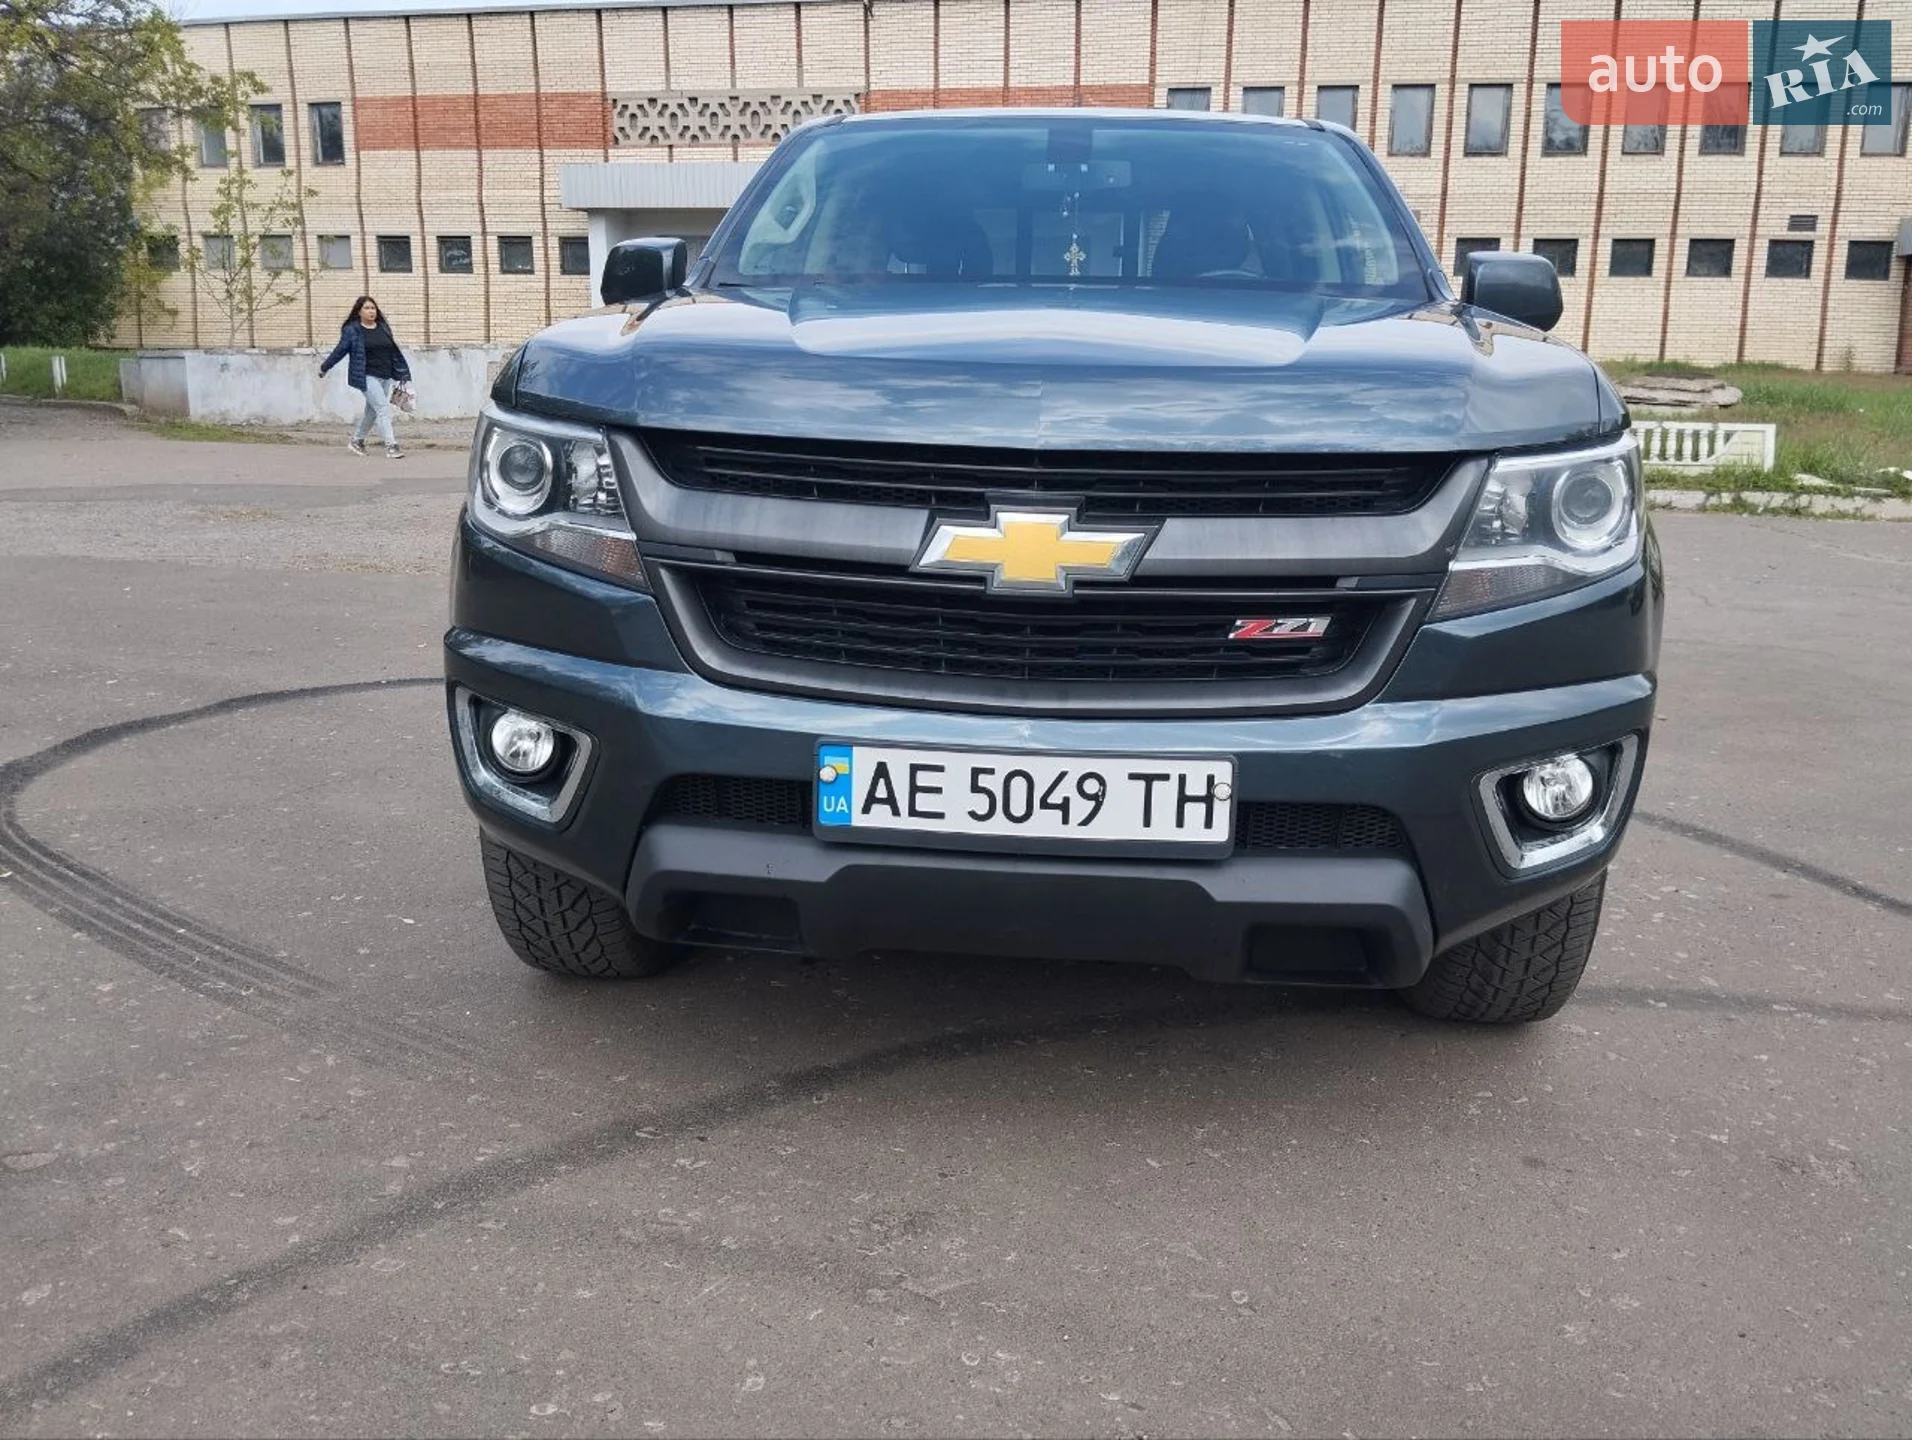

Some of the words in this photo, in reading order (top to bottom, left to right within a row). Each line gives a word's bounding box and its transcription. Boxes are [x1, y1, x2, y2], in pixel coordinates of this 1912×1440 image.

[1228, 617, 1332, 639] Z71
[823, 795, 849, 814] UA
[861, 761, 946, 819] AE
[967, 766, 1107, 827] 5049
[1127, 772, 1215, 829] TH
